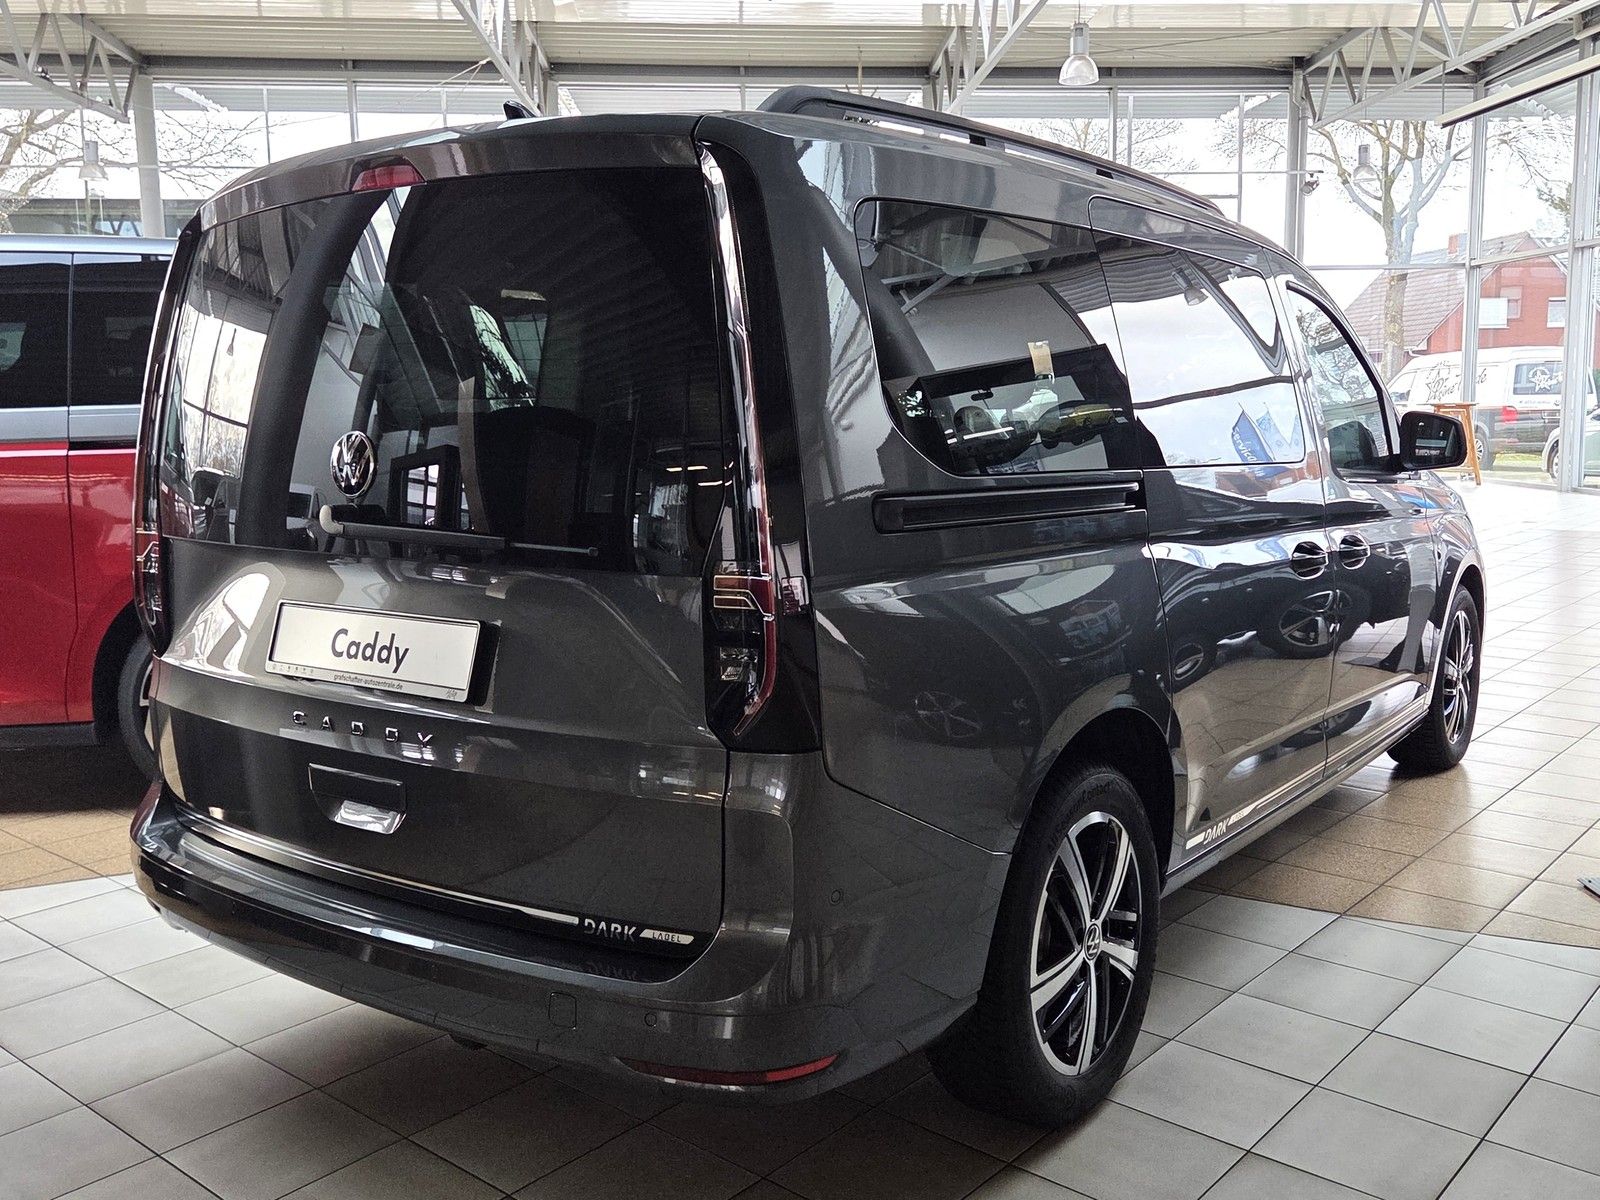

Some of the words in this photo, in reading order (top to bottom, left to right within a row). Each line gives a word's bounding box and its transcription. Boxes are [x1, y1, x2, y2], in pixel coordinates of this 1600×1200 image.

[331, 628, 409, 673] Caddy
[292, 710, 433, 748] CADDY
[1203, 818, 1230, 845] DARK
[584, 918, 637, 943] DARK
